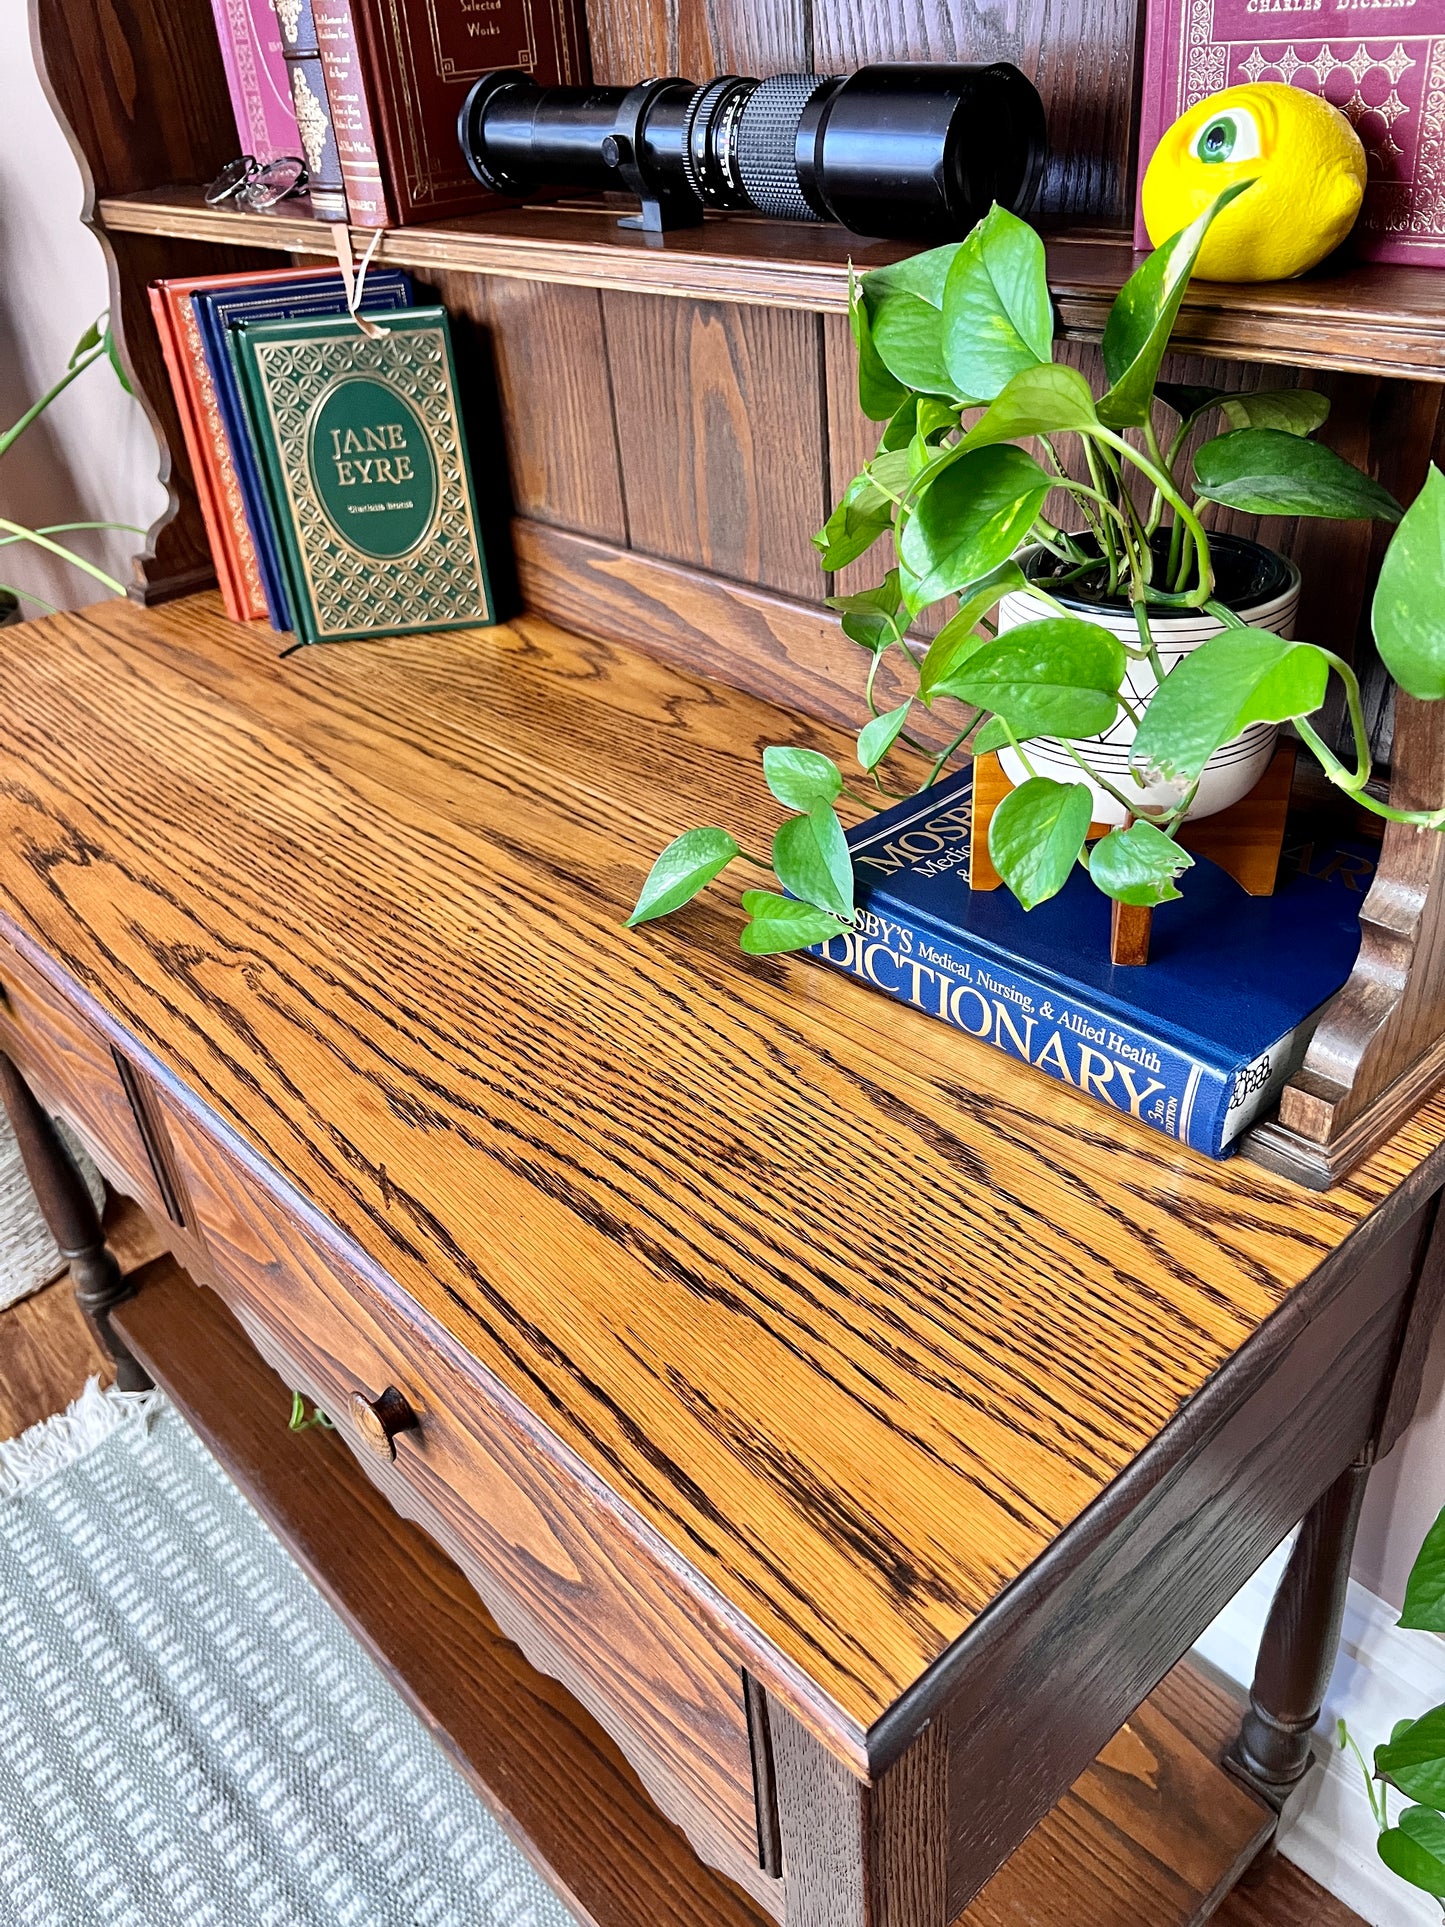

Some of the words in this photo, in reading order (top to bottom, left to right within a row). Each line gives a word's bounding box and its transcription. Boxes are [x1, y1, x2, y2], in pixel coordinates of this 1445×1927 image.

[460, 0, 502, 13] Selected
[1246, 0, 1323, 13] CHARLES
[1336, 0, 1417, 10] DICKENS
[466, 21, 501, 38] Works
[330, 424, 407, 460] JANE
[336, 456, 415, 485] EYRE
[911, 845, 971, 878] Medic
[827, 907, 914, 953] SBY'S
[918, 941, 974, 983] Medical,
[976, 969, 1036, 1013] Nursing,
[1039, 1001, 1055, 1020] &
[1056, 1010, 1106, 1046] Allied
[1105, 1031, 1162, 1074] Health
[819, 932, 1167, 1124] DICTIONARY
[1147, 1099, 1165, 1125] 3RD
[1165, 1095, 1179, 1136] EDITION
